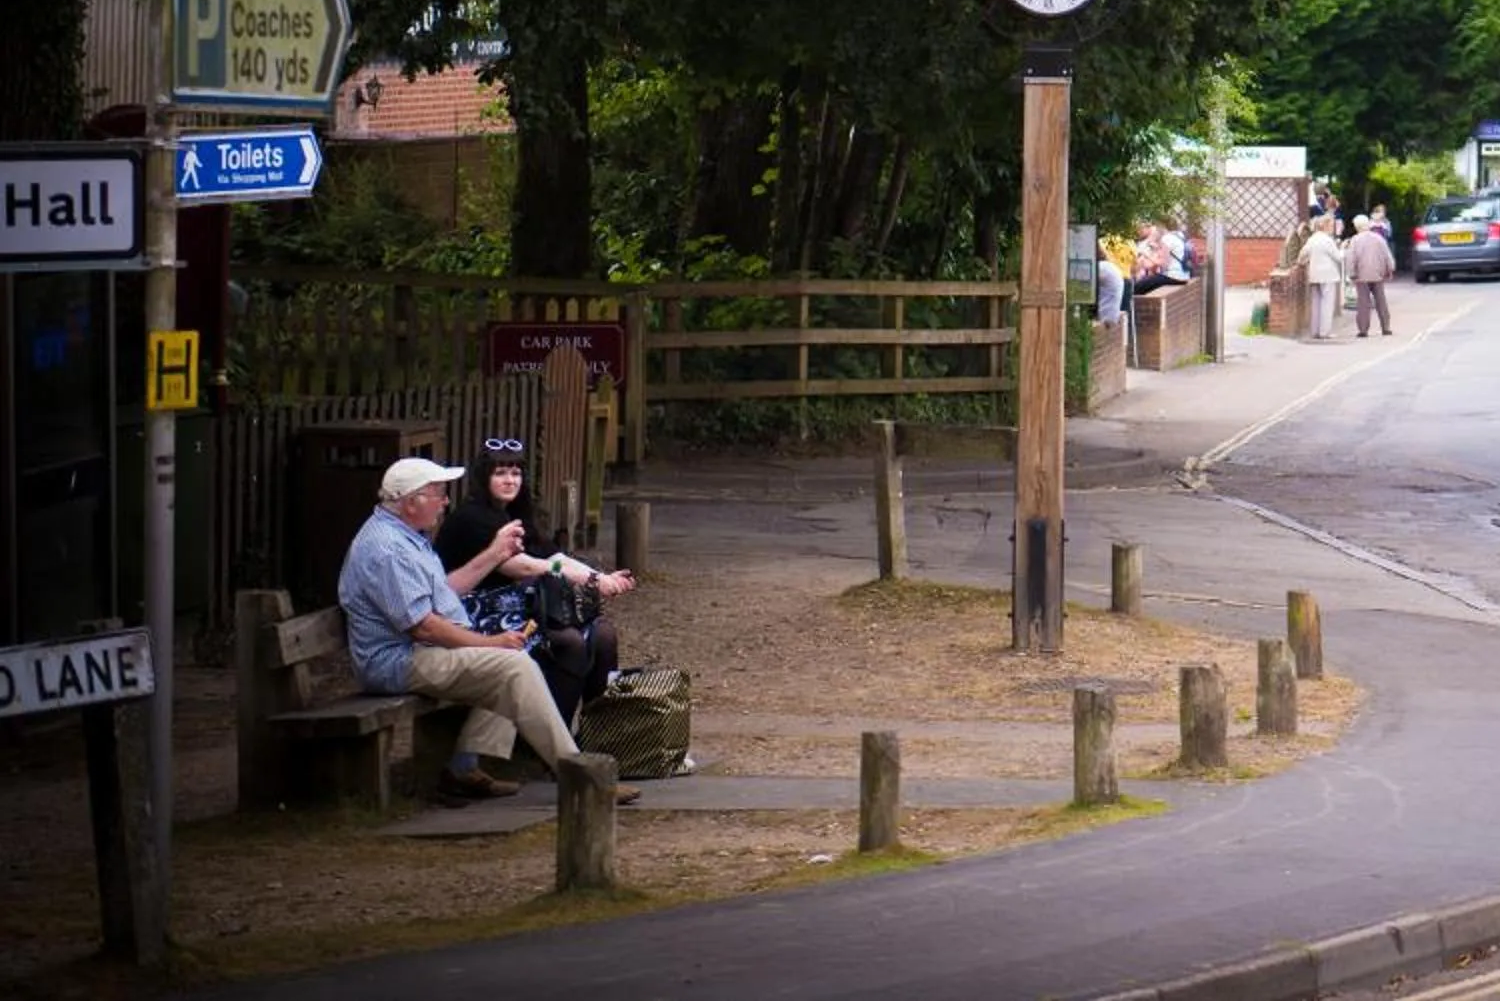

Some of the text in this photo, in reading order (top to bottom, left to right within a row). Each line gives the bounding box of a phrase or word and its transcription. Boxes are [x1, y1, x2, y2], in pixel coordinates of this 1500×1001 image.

[230, 0, 313, 39] Coaches
[232, 47, 310, 91] 140 yds
[217, 142, 284, 170] Toilets
[5, 181, 114, 227] Hall
[520, 335, 551, 349] CAR
[157, 339, 192, 401] H
[34, 647, 138, 702] LANE
